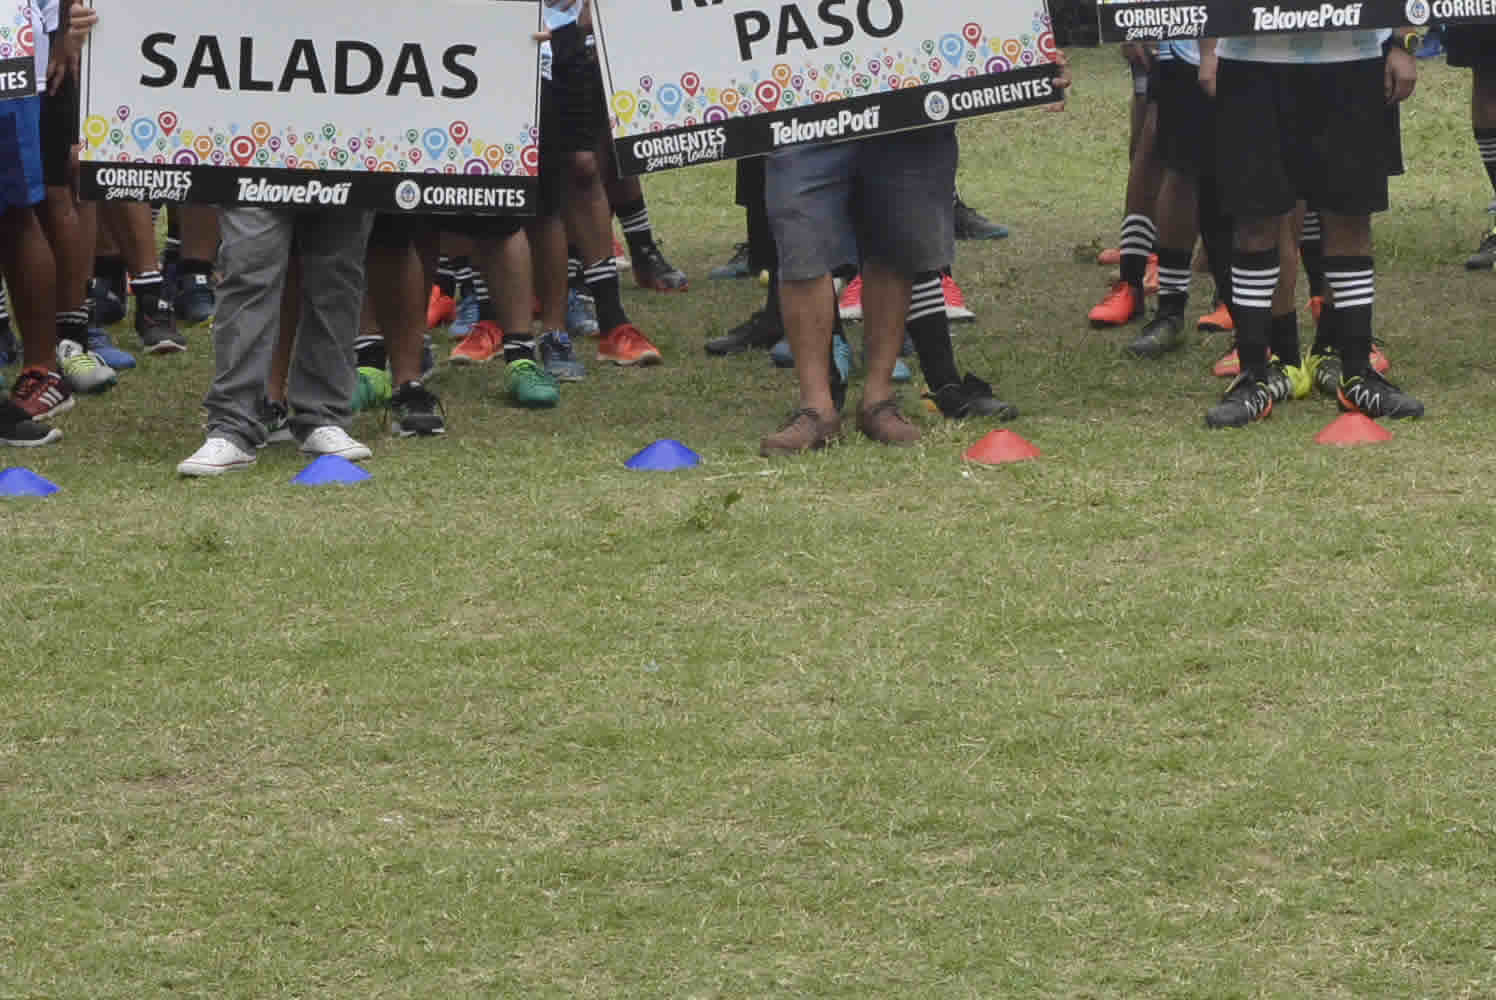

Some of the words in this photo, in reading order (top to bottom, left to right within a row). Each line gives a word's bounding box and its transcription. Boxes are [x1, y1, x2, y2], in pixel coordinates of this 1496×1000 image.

[1115, 6, 1208, 27] CORRIENTES
[139, 32, 478, 99] SALADAS
[951, 77, 1053, 113] CORRIENTES
[633, 127, 727, 159] CORRIENTES
[96, 168, 192, 188] CORRIENTES
[423, 185, 526, 208] CORRIENTES
